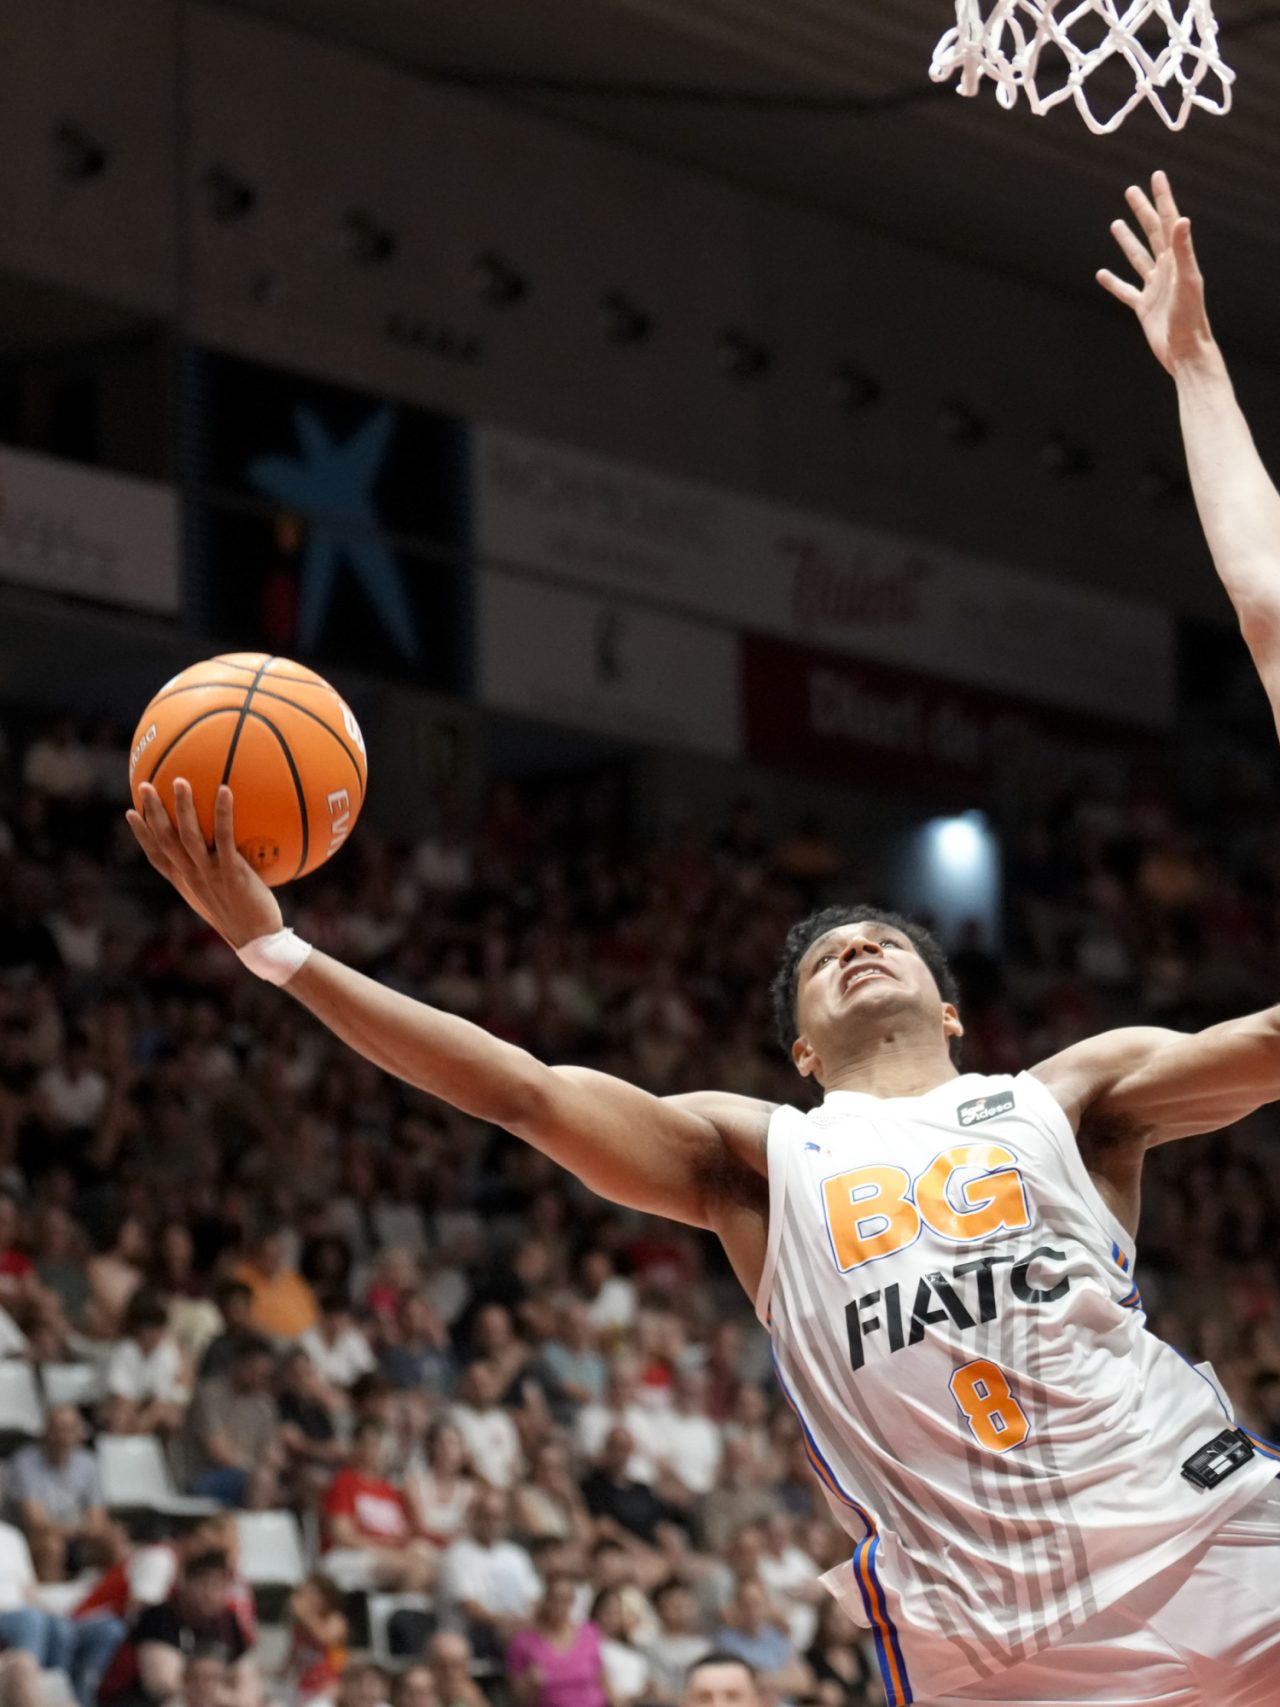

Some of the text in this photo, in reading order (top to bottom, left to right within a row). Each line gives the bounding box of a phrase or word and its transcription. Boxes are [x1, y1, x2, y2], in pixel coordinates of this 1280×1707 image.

[821, 1143, 1032, 1273] BG
[845, 1246, 1070, 1371] FIATC
[949, 1358, 1031, 1453] 8
